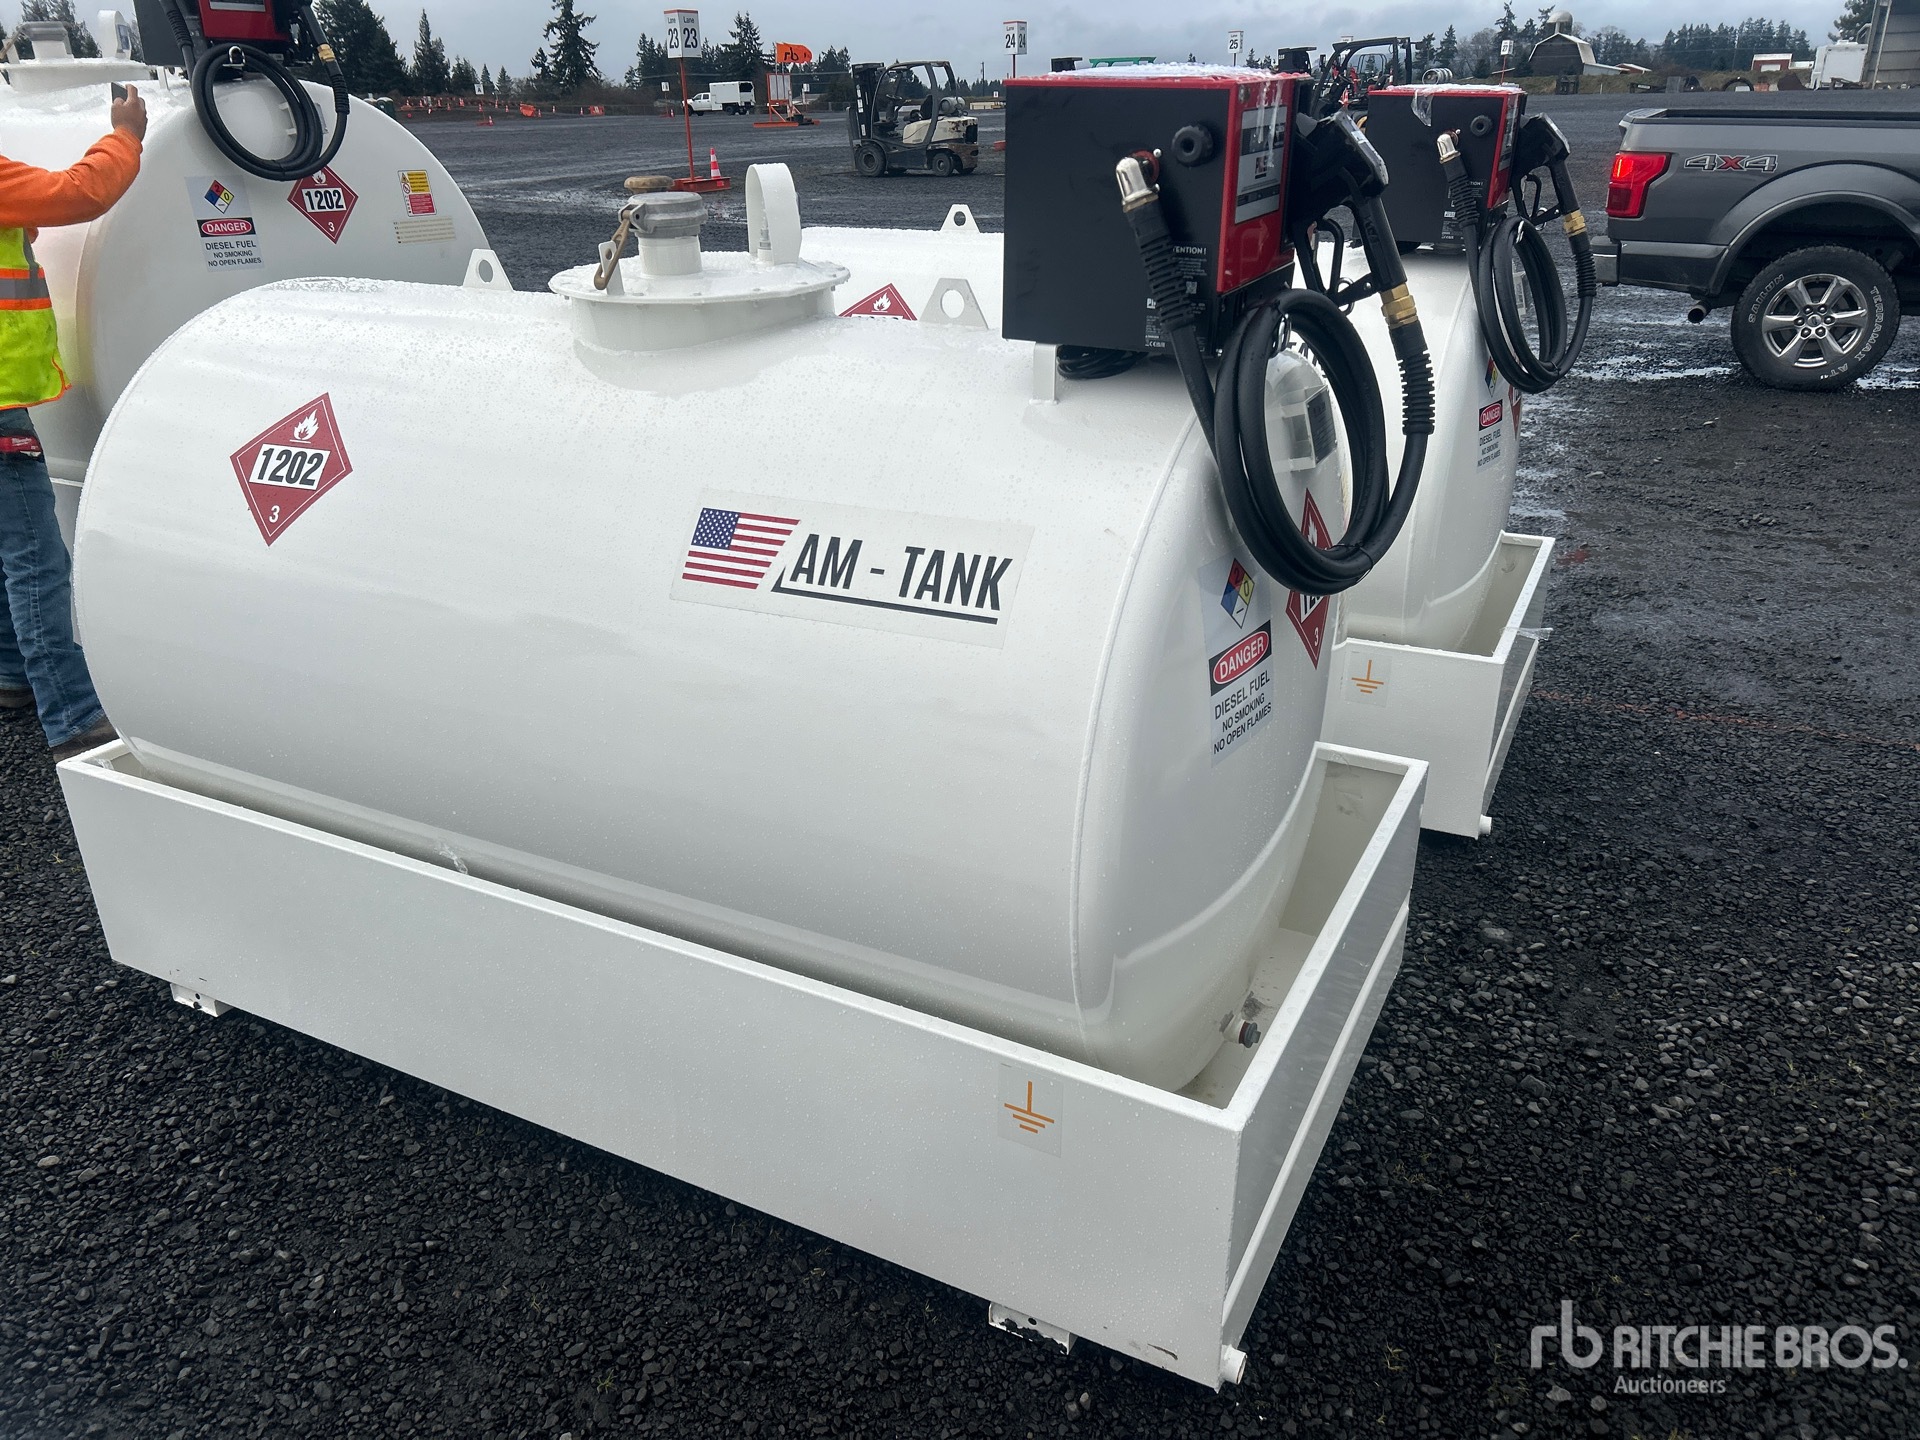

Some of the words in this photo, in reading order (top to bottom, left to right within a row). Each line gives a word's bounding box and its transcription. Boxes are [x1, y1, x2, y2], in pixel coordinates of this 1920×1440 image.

[683, 16, 694, 24] Lane
[668, 28, 679, 48] 23
[683, 27, 698, 48] 23
[1005, 33, 1016, 48] 24
[1019, 33, 1026, 48] 24
[1229, 39, 1239, 50] 25
[784, 46, 799, 61] rb
[305, 189, 344, 211] 1202
[206, 222, 248, 233] DANGER
[328, 221, 335, 232] 3
[205, 241, 235, 250] DIESEL
[235, 240, 256, 248] FUEL
[224, 250, 253, 258] SMOKING
[237, 257, 262, 265] FLAMES
[257, 447, 324, 486] 1202
[269, 505, 281, 523] 3
[789, 533, 863, 590] AM
[898, 546, 1014, 611] TANK
[1314, 626, 1319, 647] 3
[1219, 636, 1265, 680] DANGER
[1214, 687, 1248, 720] DIESEL
[1249, 670, 1271, 696] FUEL
[1222, 716, 1234, 733] NO
[1234, 692, 1265, 724] SMOKING
[1213, 738, 1225, 755] NO
[1226, 722, 1246, 745] OPEN
[1247, 701, 1272, 730] FLAMES
